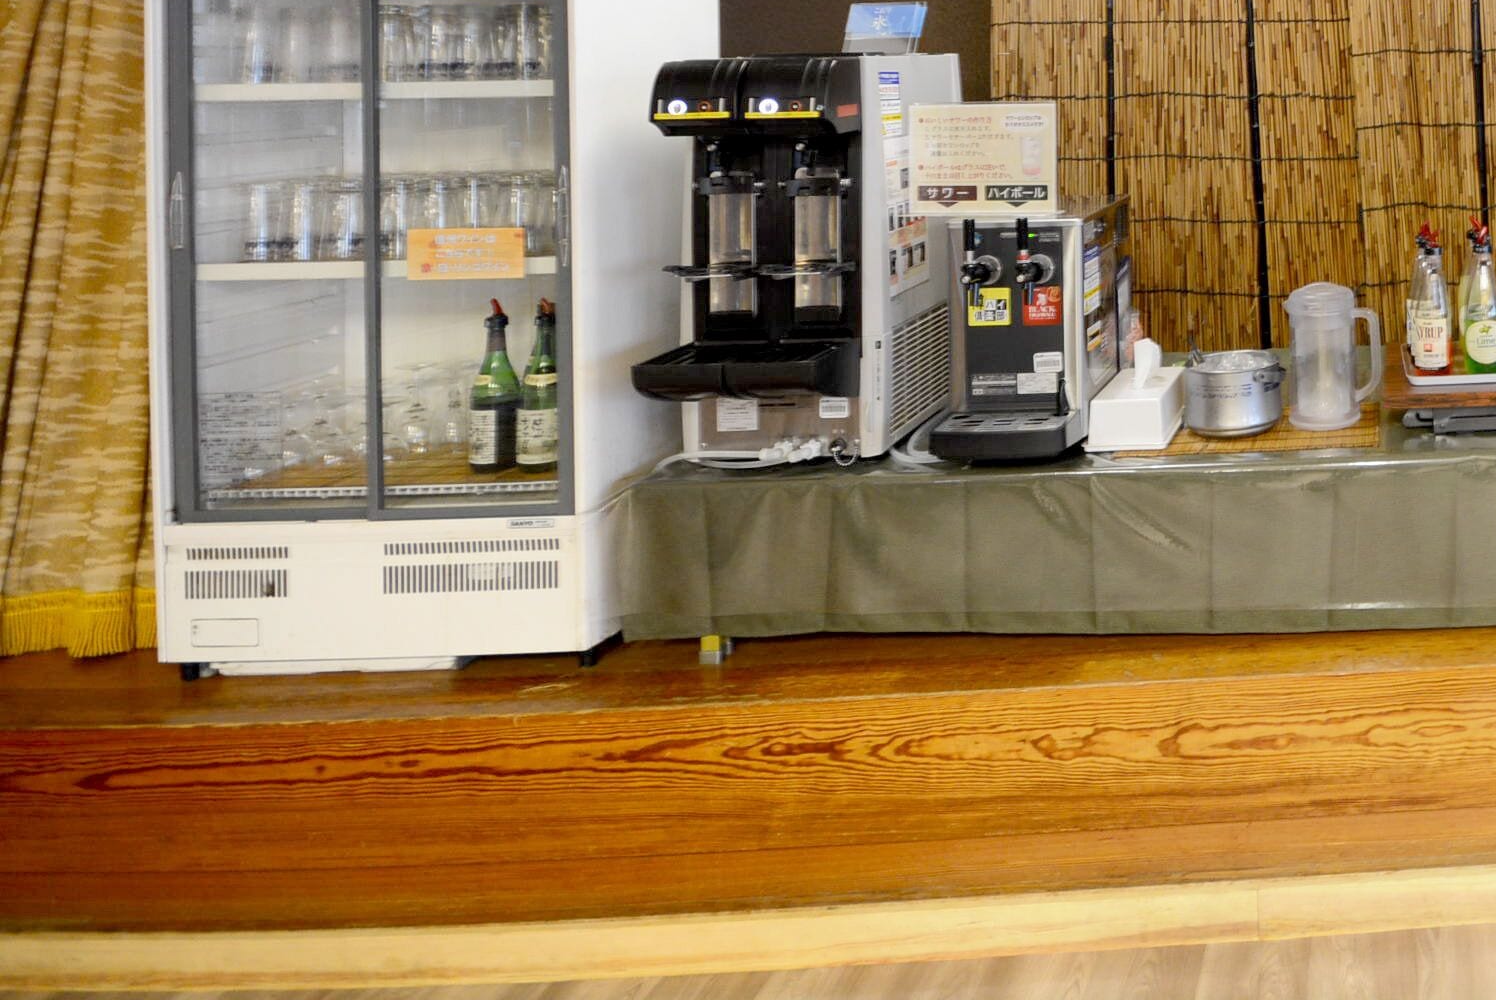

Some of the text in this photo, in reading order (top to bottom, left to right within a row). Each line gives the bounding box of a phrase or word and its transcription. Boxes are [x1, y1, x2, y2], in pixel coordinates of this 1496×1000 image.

[926, 186, 970, 199] サワー
[987, 186, 1046, 199] ハイボール
